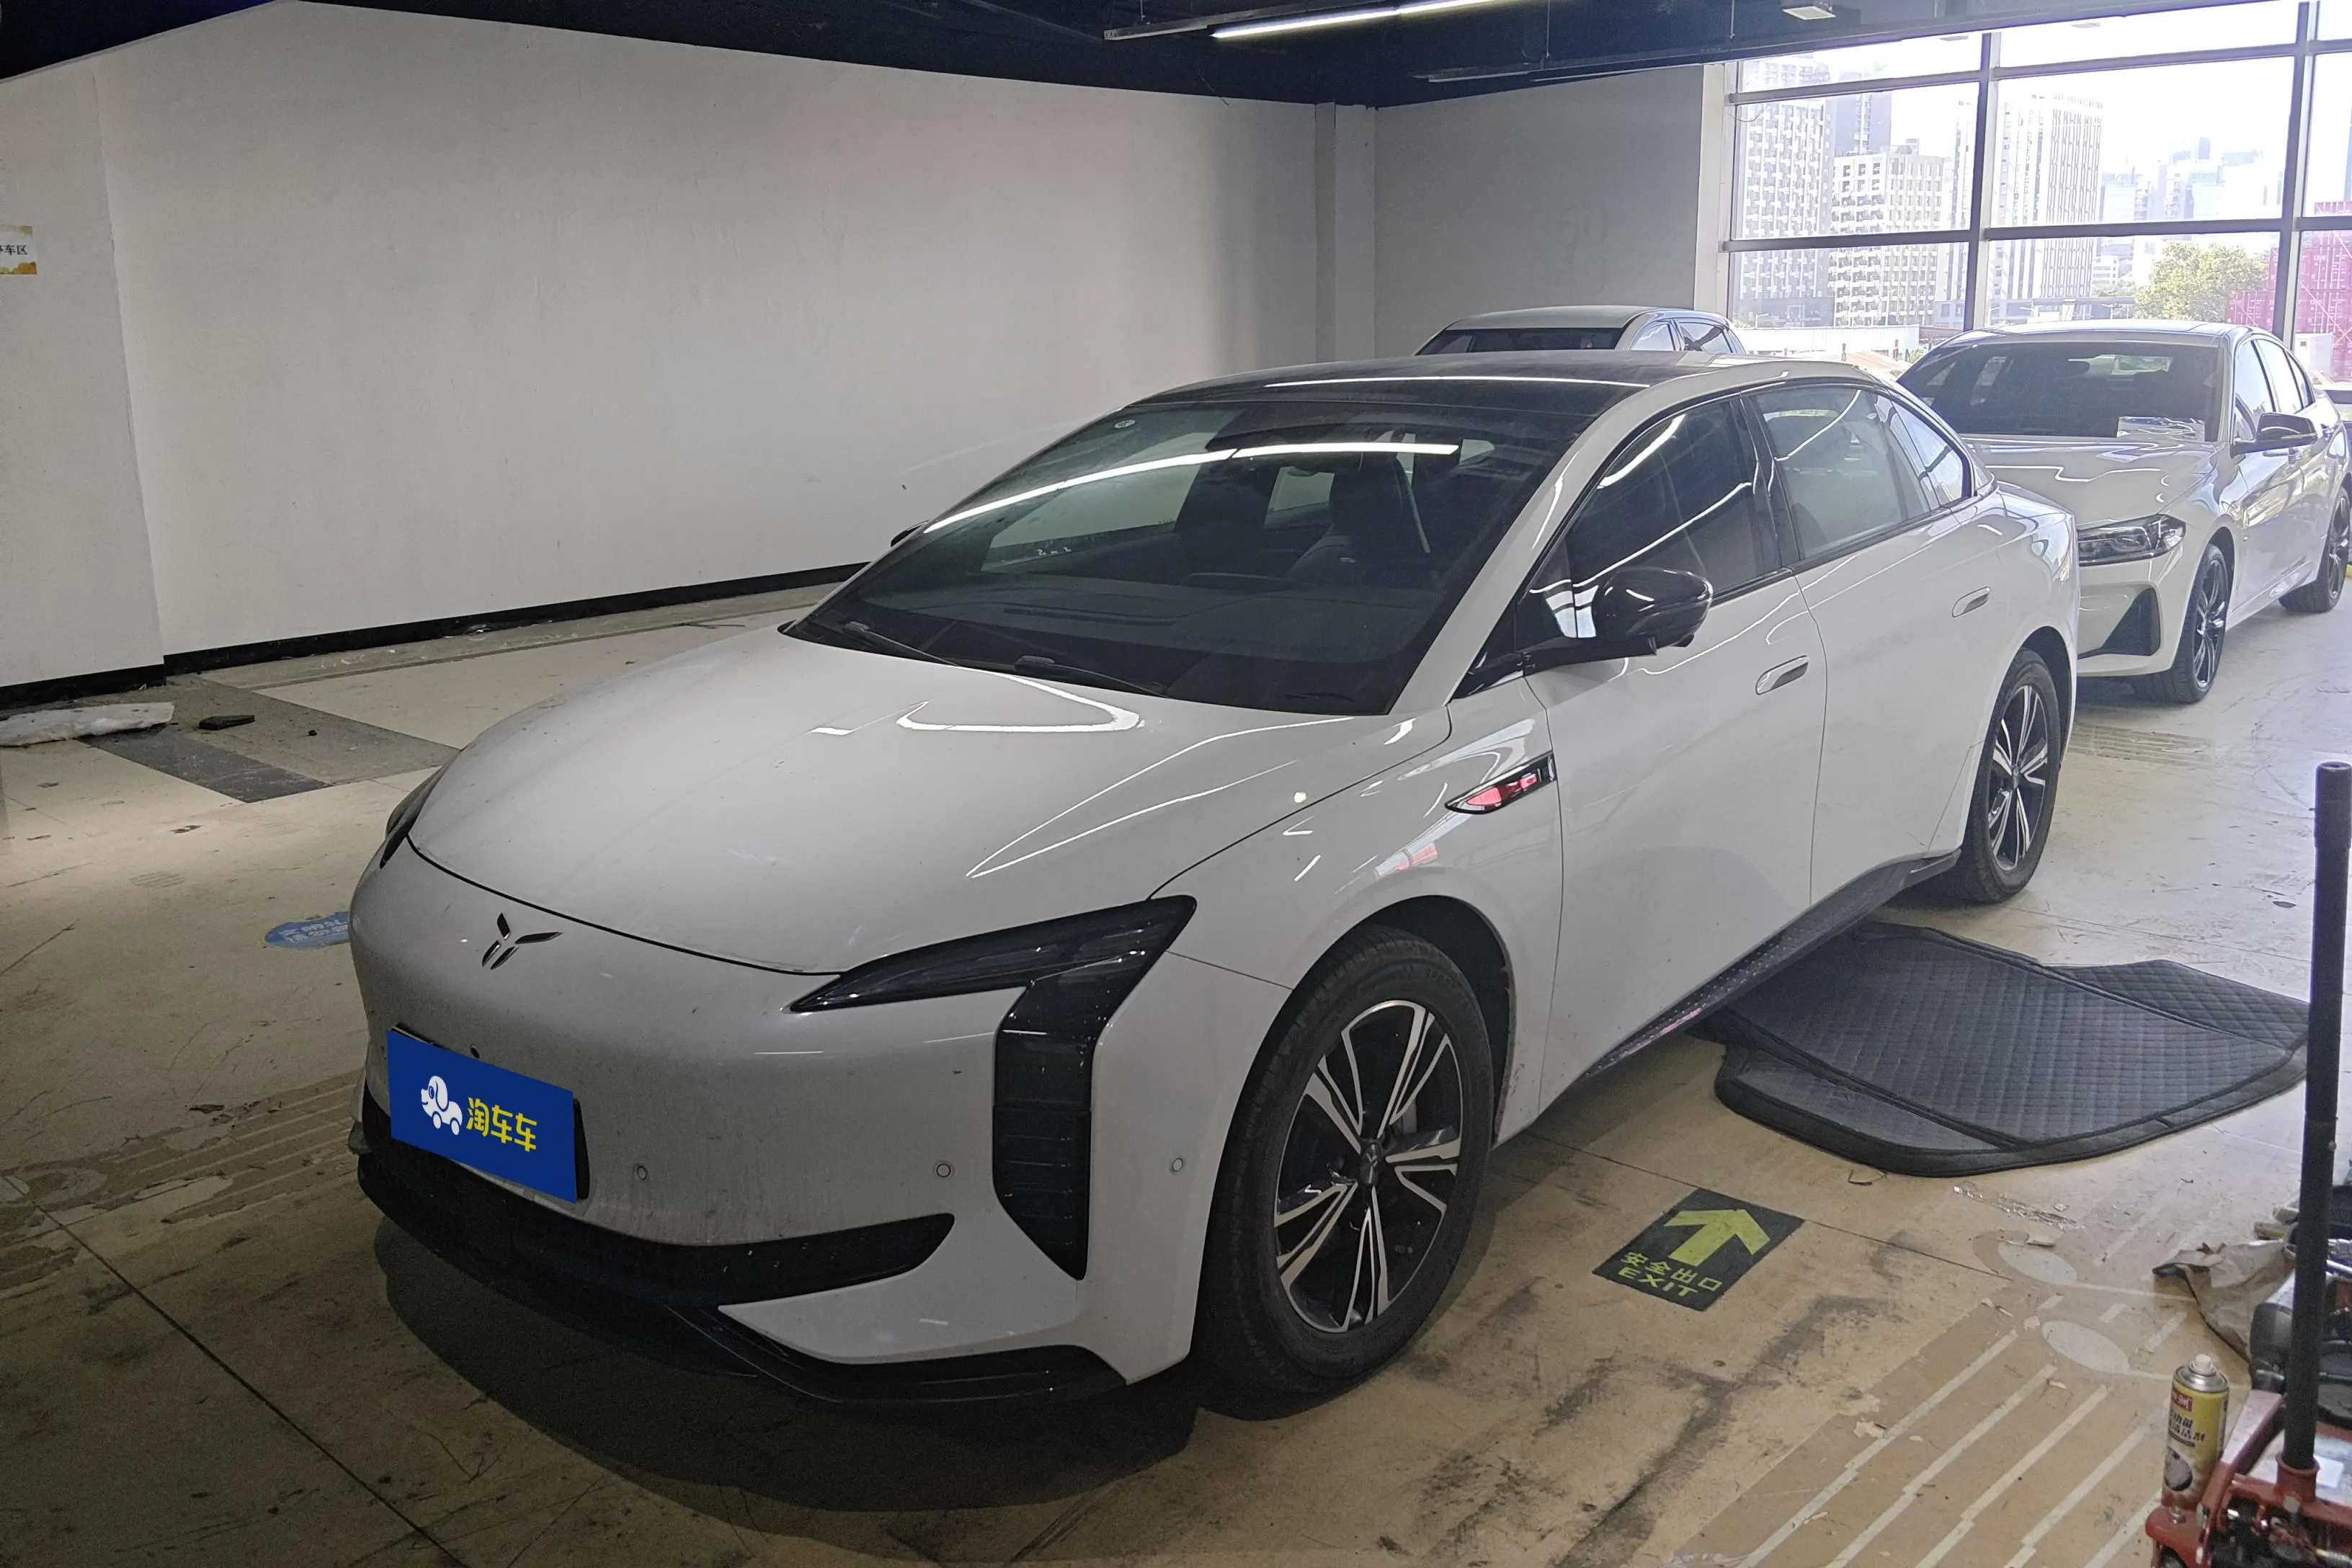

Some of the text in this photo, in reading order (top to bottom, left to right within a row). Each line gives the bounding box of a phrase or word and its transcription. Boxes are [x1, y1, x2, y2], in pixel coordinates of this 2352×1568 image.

[1618, 1267, 1698, 1296] EXIT
[1621, 1251, 1723, 1292] 安全出口
